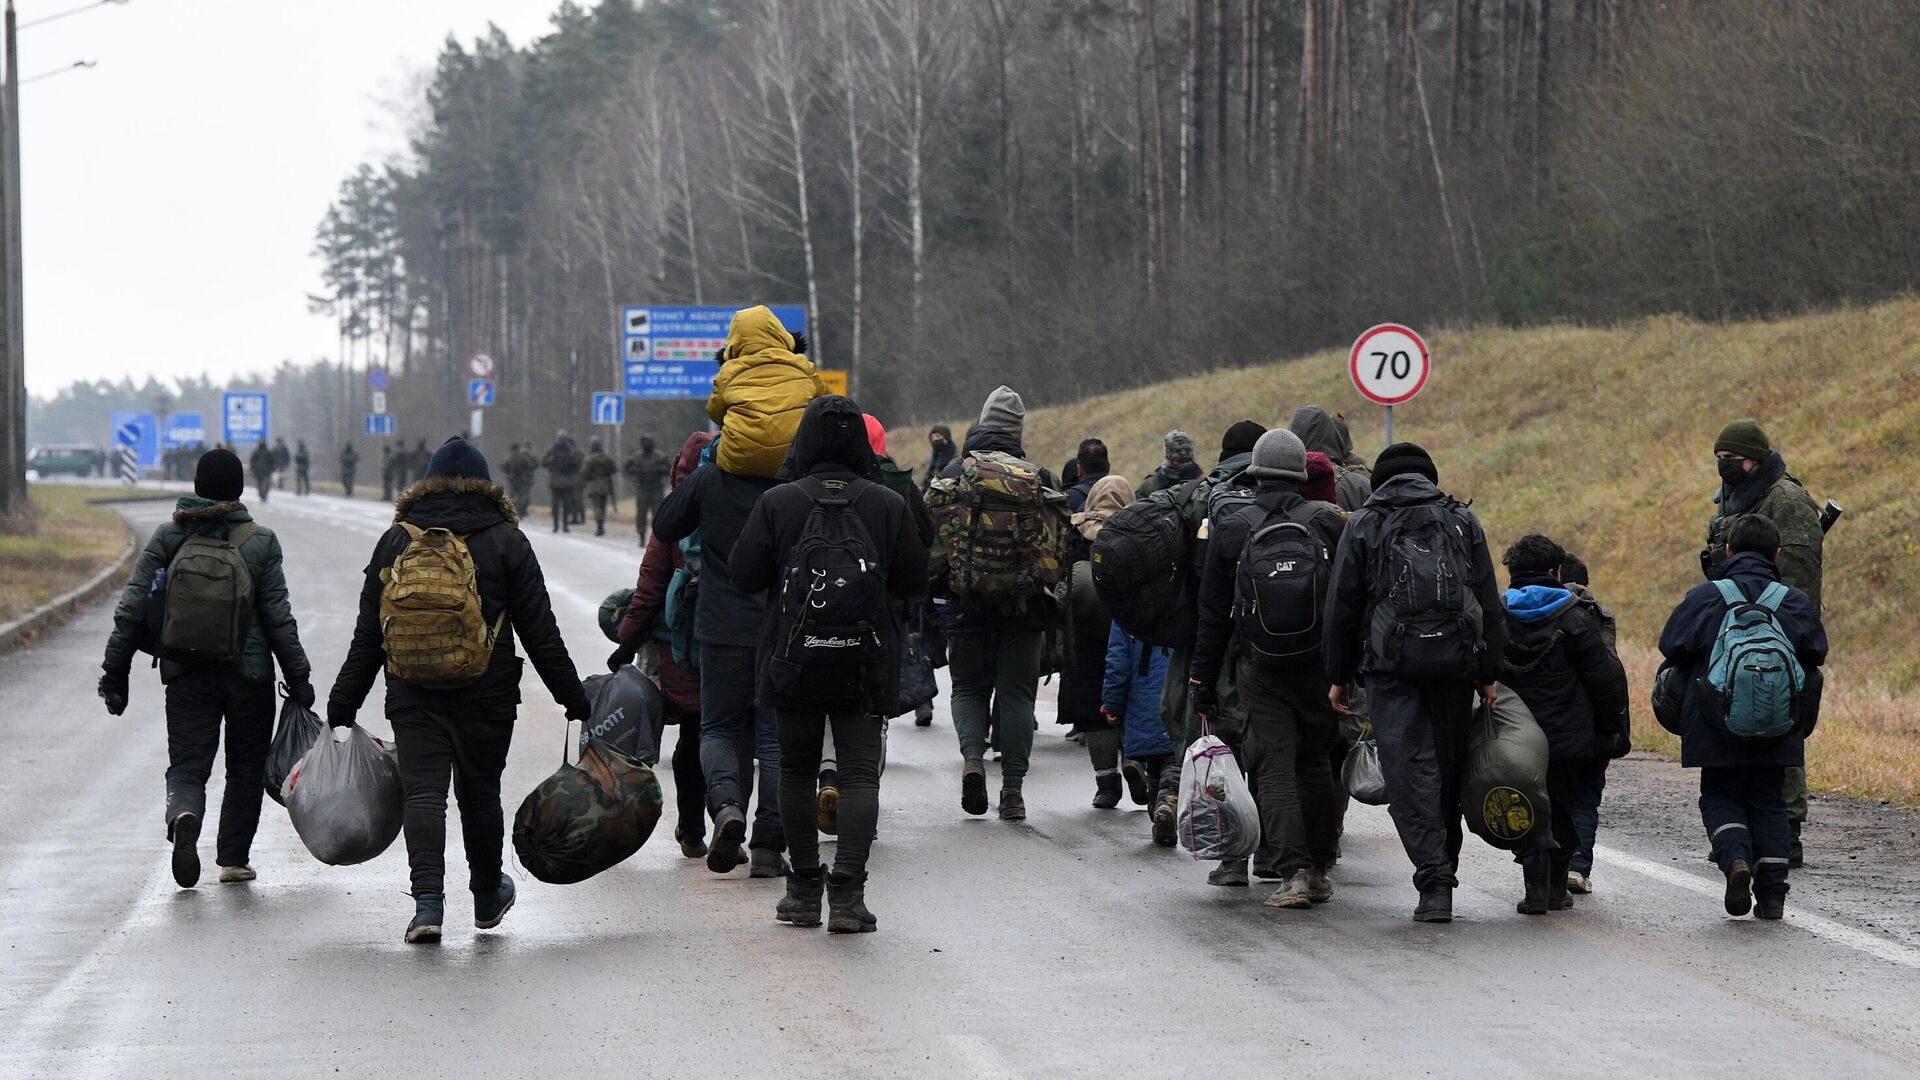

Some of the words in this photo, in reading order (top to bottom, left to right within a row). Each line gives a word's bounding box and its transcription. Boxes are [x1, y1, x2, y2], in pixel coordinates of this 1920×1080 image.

[652, 322, 720, 333] DISTRIBUTION
[1370, 351, 1410, 380] 70
[1276, 561, 1297, 572] CAT
[803, 634, 846, 648] Yankees
